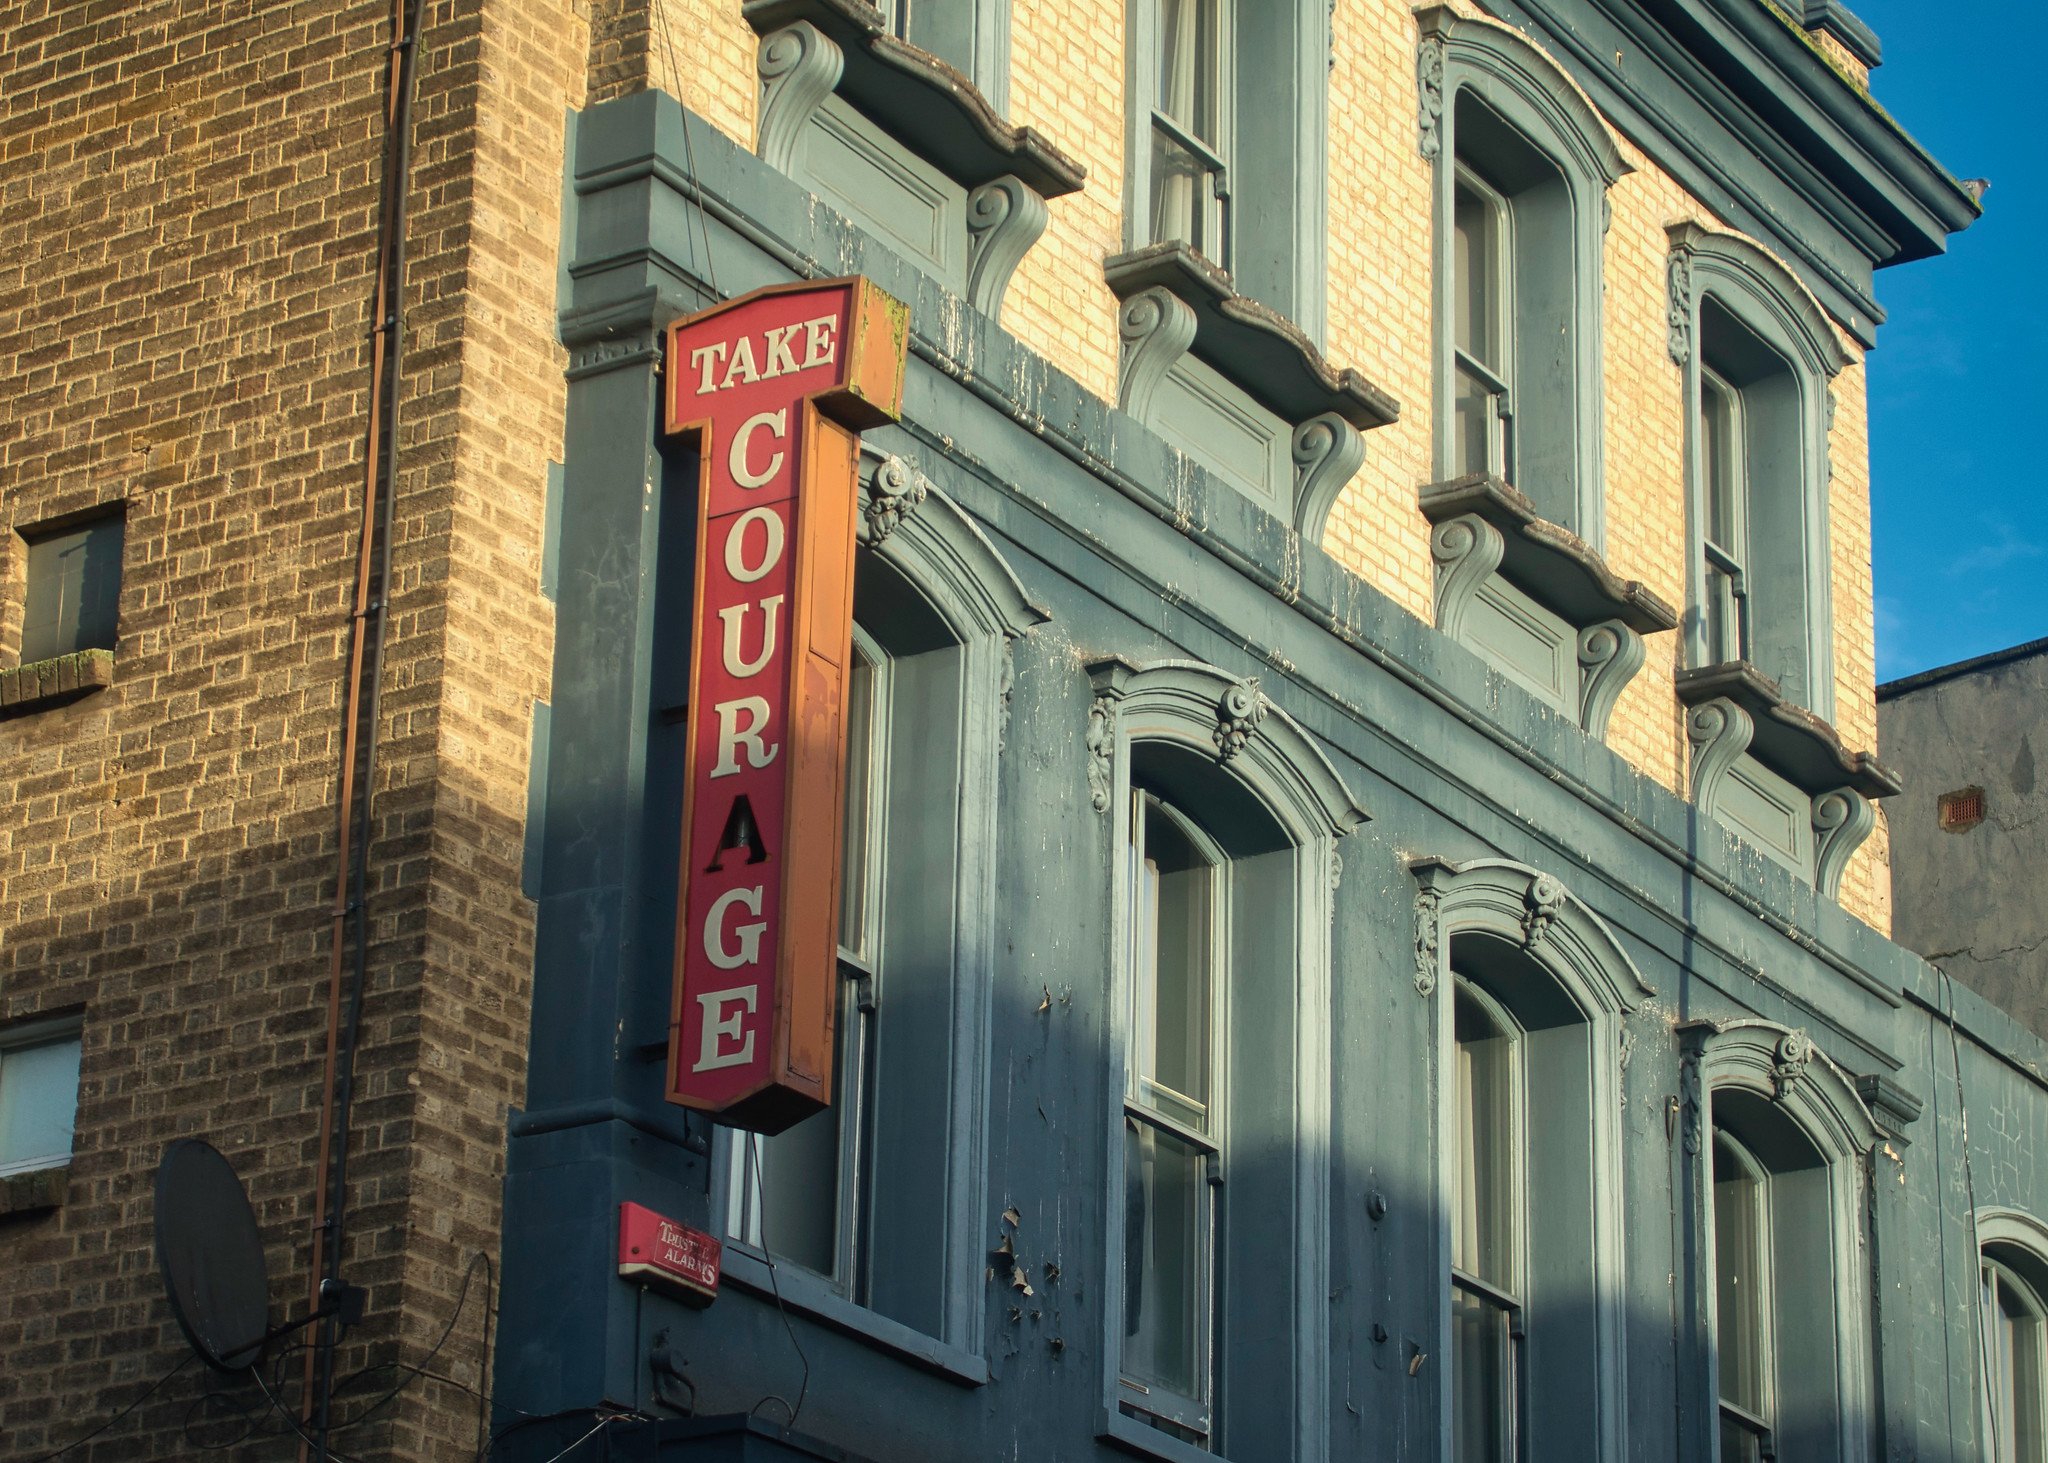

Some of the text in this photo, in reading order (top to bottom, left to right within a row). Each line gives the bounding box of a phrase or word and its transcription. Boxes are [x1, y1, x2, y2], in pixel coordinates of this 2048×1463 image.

[690, 314, 837, 395] TAKE
[692, 408, 787, 1073] COURAGE
[664, 1248, 715, 1285] ALARMS
